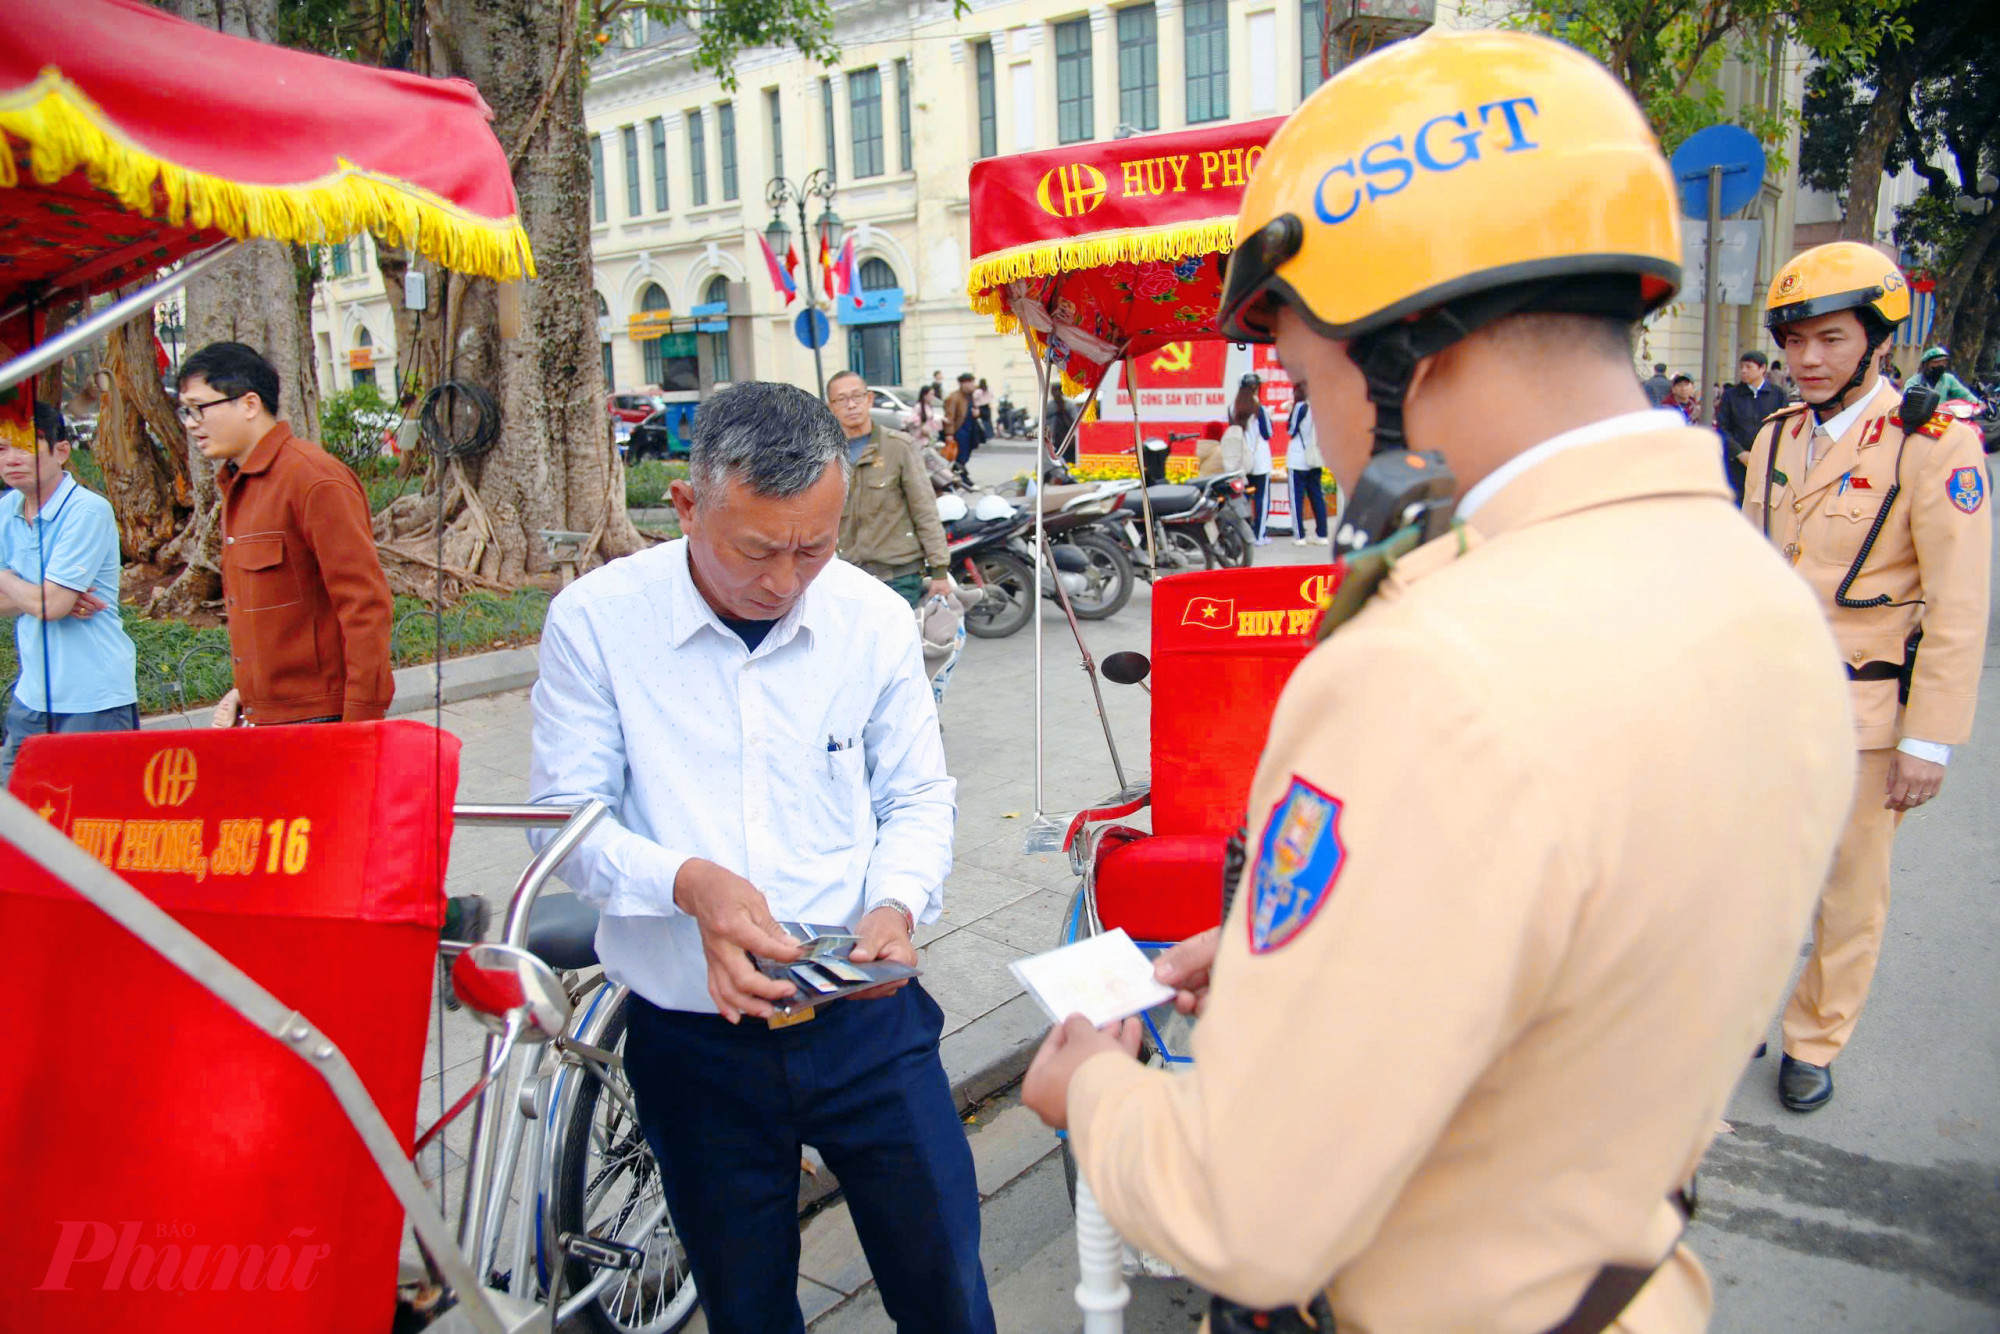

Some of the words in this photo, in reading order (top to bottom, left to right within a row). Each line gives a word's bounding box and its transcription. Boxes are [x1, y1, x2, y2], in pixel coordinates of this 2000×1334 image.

[1120, 154, 1189, 198] HUY
[1314, 97, 1539, 225] CSGT
[1206, 392, 1225, 405] NAM
[1237, 611, 1286, 636] HUY
[117, 818, 207, 883] PHONG,
[212, 818, 263, 876] JSC
[266, 817, 312, 875] 16
